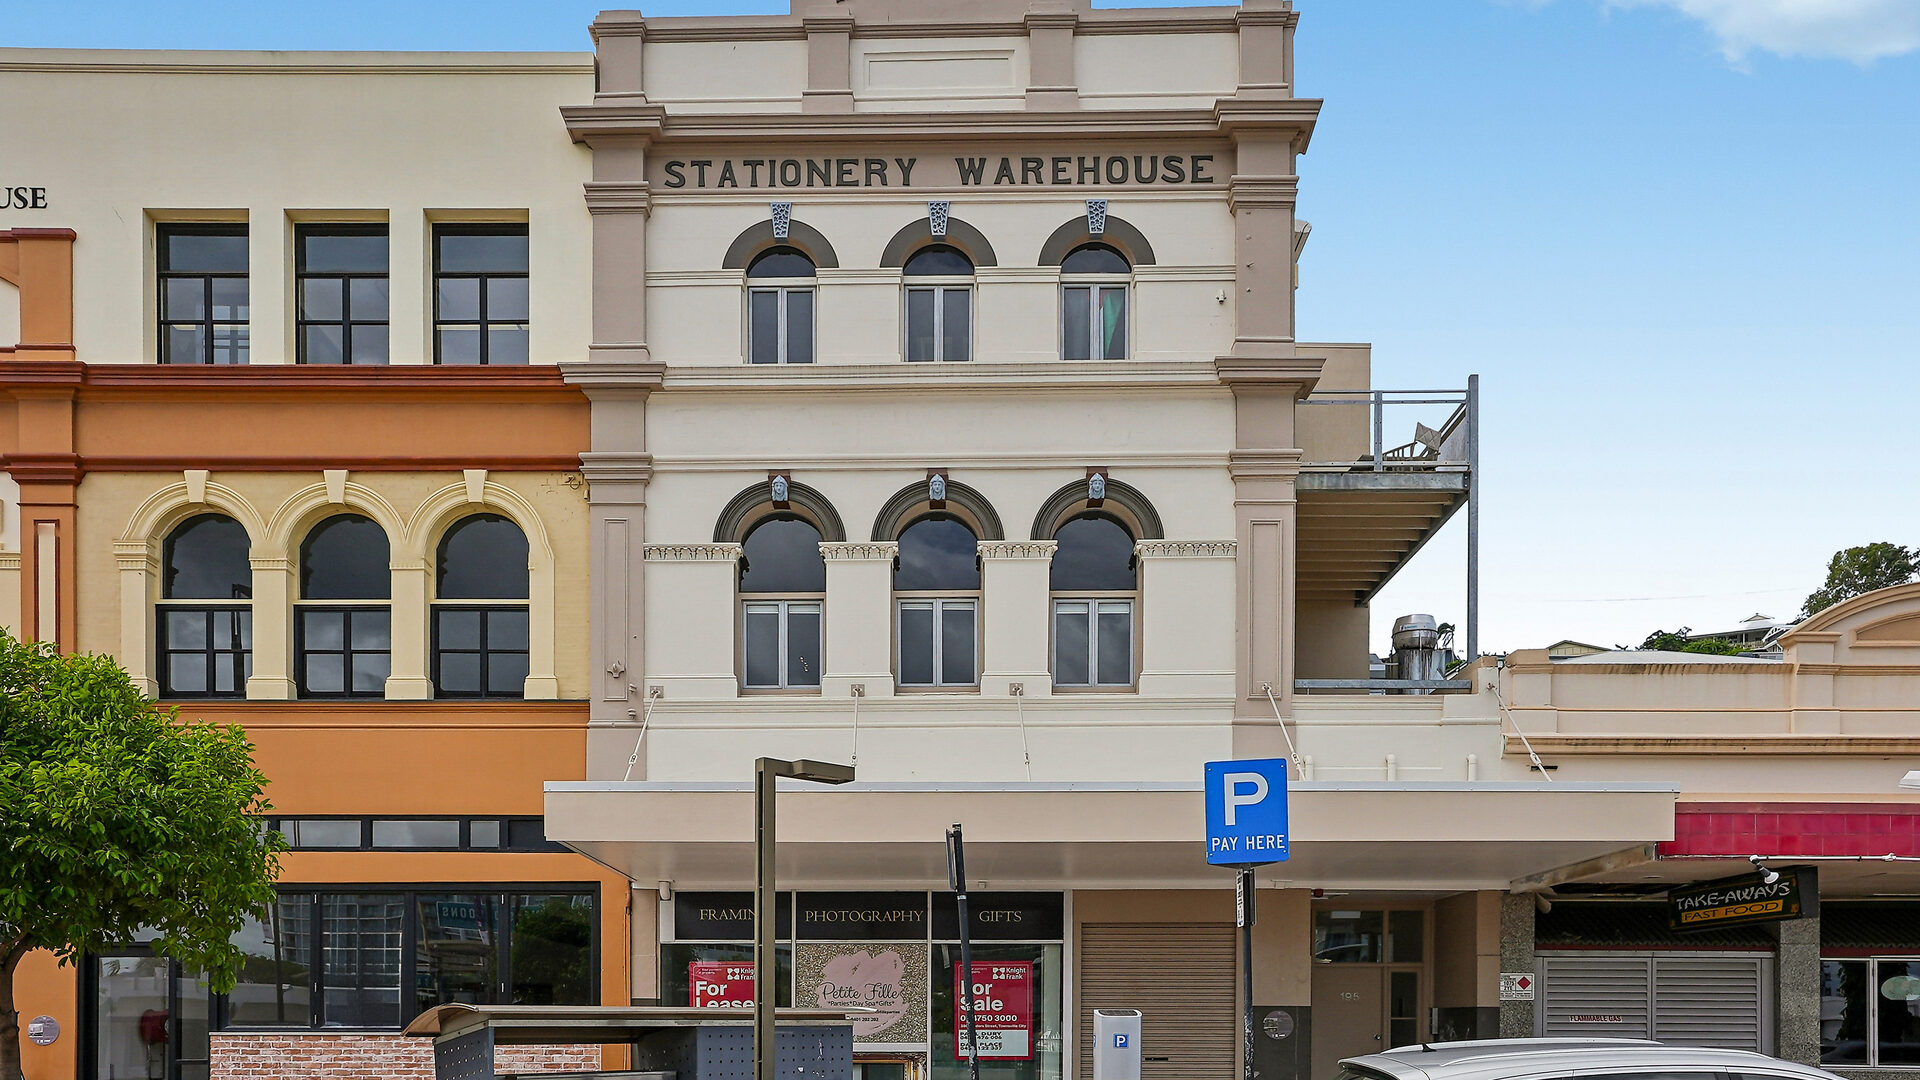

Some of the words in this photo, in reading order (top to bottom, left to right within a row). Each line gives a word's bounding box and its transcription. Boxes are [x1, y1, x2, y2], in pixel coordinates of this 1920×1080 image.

[664, 158, 916, 188] STATIONERY
[955, 155, 1214, 185] WAREHOUSE
[1224, 772, 1269, 826] P
[1211, 836, 1239, 852] PAY
[1246, 834, 1286, 850] HERE
[1676, 882, 1791, 911] TAKE-AWAYS
[700, 908, 756, 921] FRAMIN
[805, 910, 924, 922] PHOTOGRAPHY
[979, 910, 1022, 922] GIFTS
[1684, 909, 1719, 920] FAST
[1724, 902, 1779, 916] FOOD
[740, 967, 755, 975] Knig
[1005, 967, 1026, 976] Knight
[695, 981, 728, 996] For
[820, 981, 861, 1000] Petite
[864, 982, 899, 1001] Fille
[994, 1014, 1018, 1022] 3000
[1117, 1035, 1126, 1047] P
